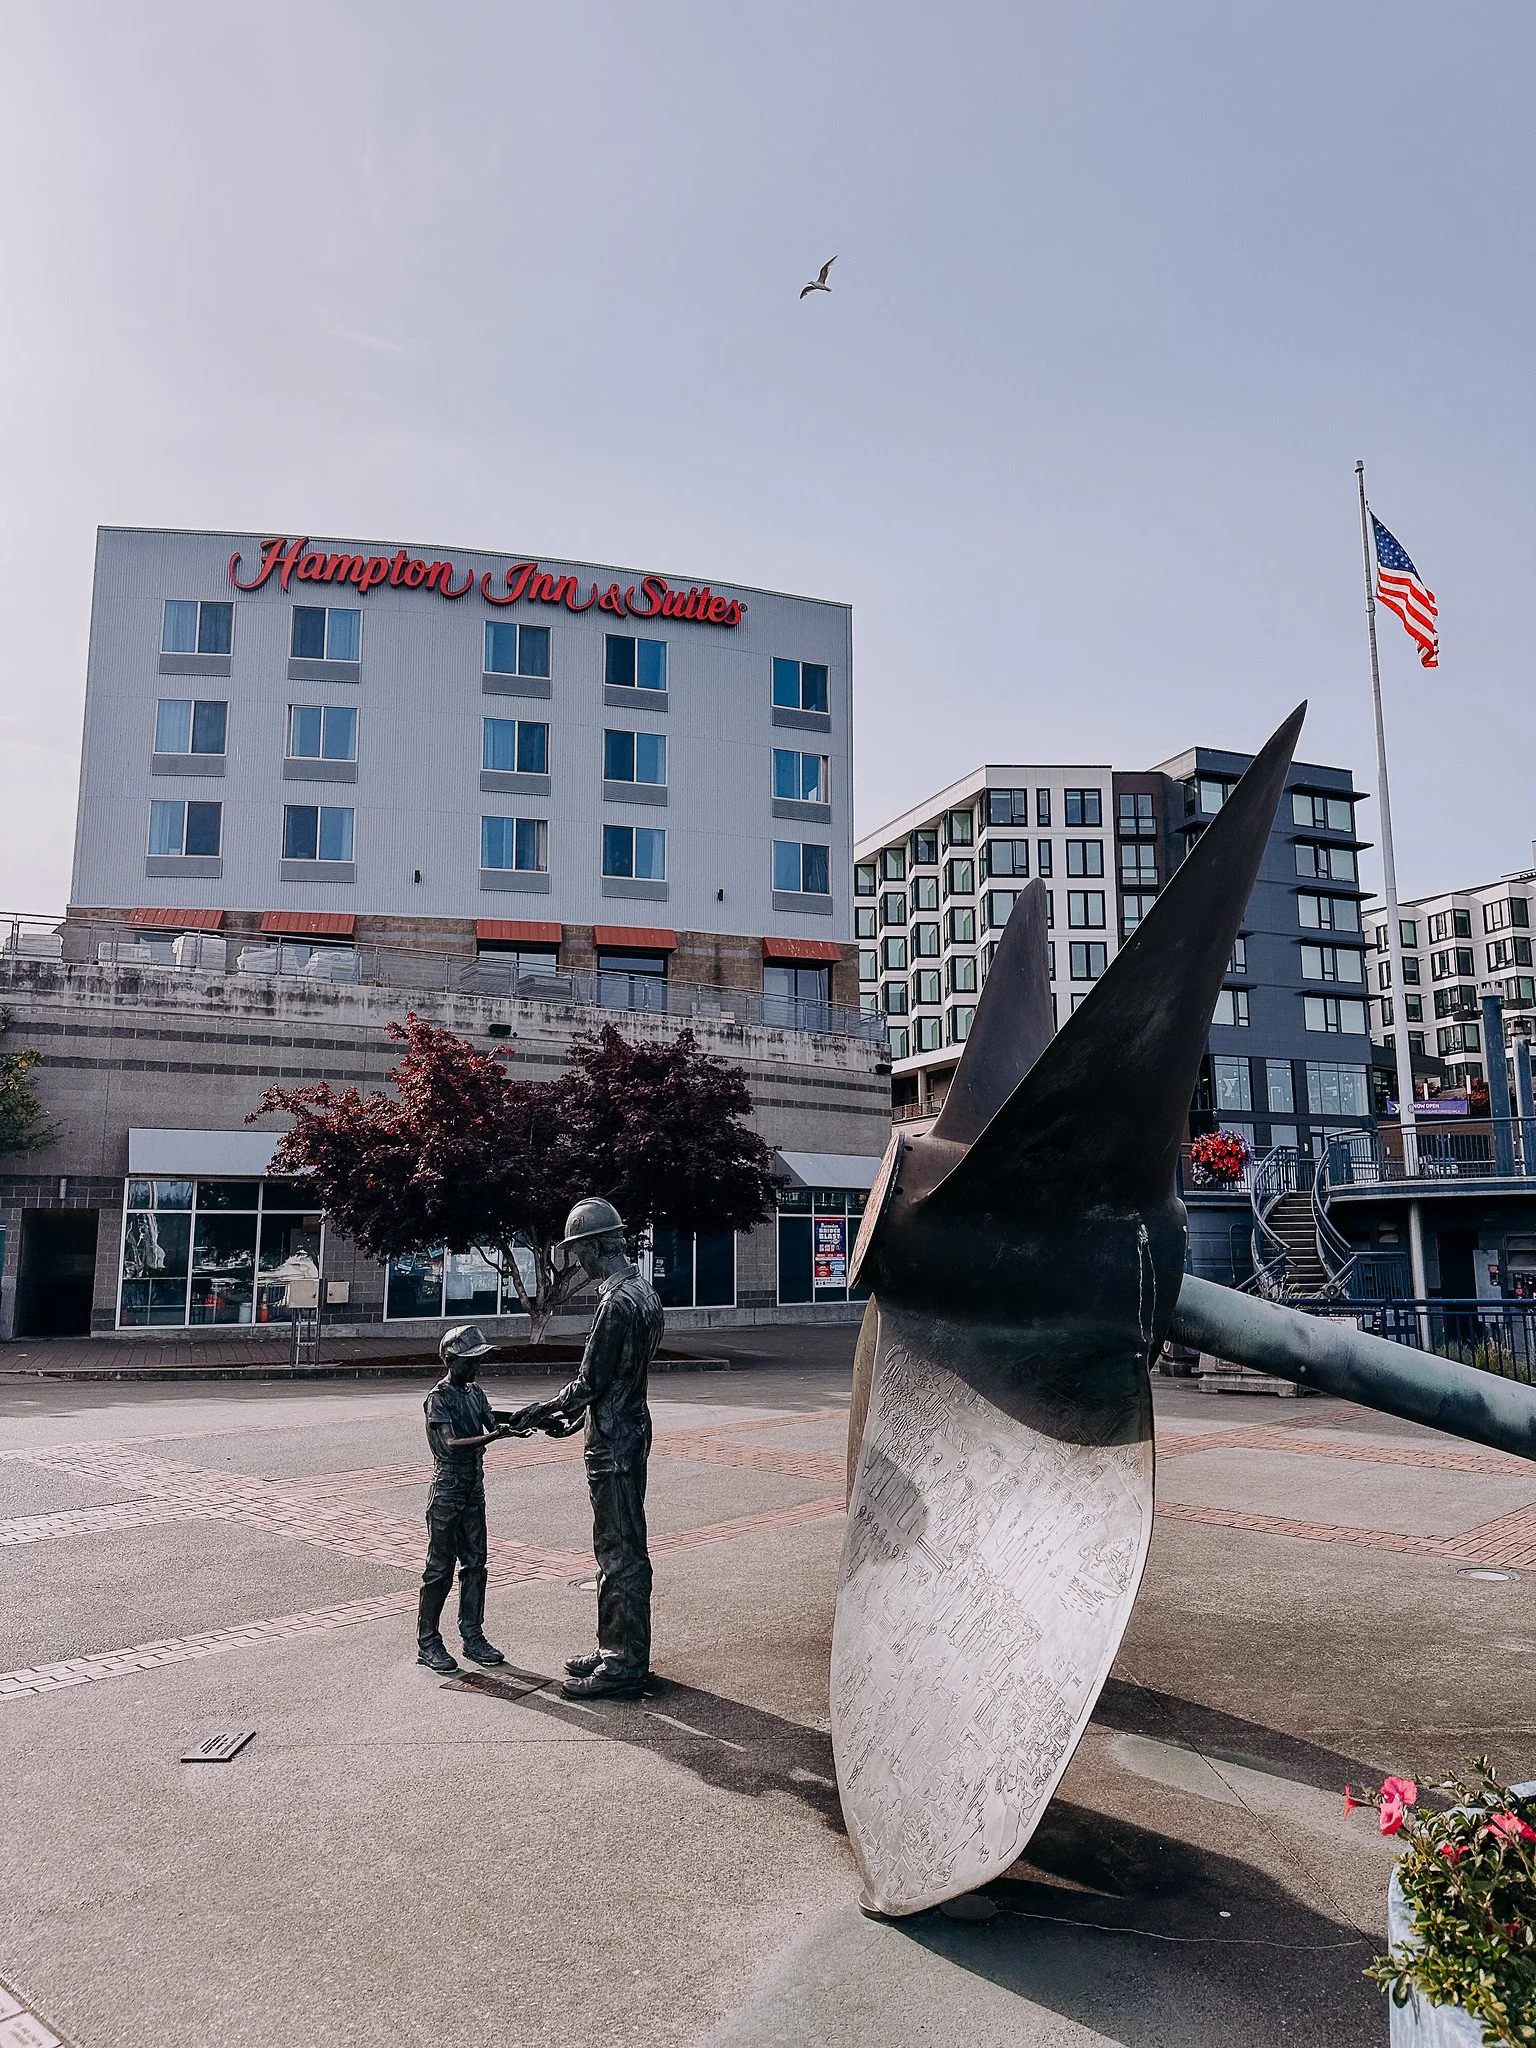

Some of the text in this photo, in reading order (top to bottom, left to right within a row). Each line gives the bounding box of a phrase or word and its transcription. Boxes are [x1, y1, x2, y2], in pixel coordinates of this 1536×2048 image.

[228, 536, 745, 626] Hampton Inn & Suites
